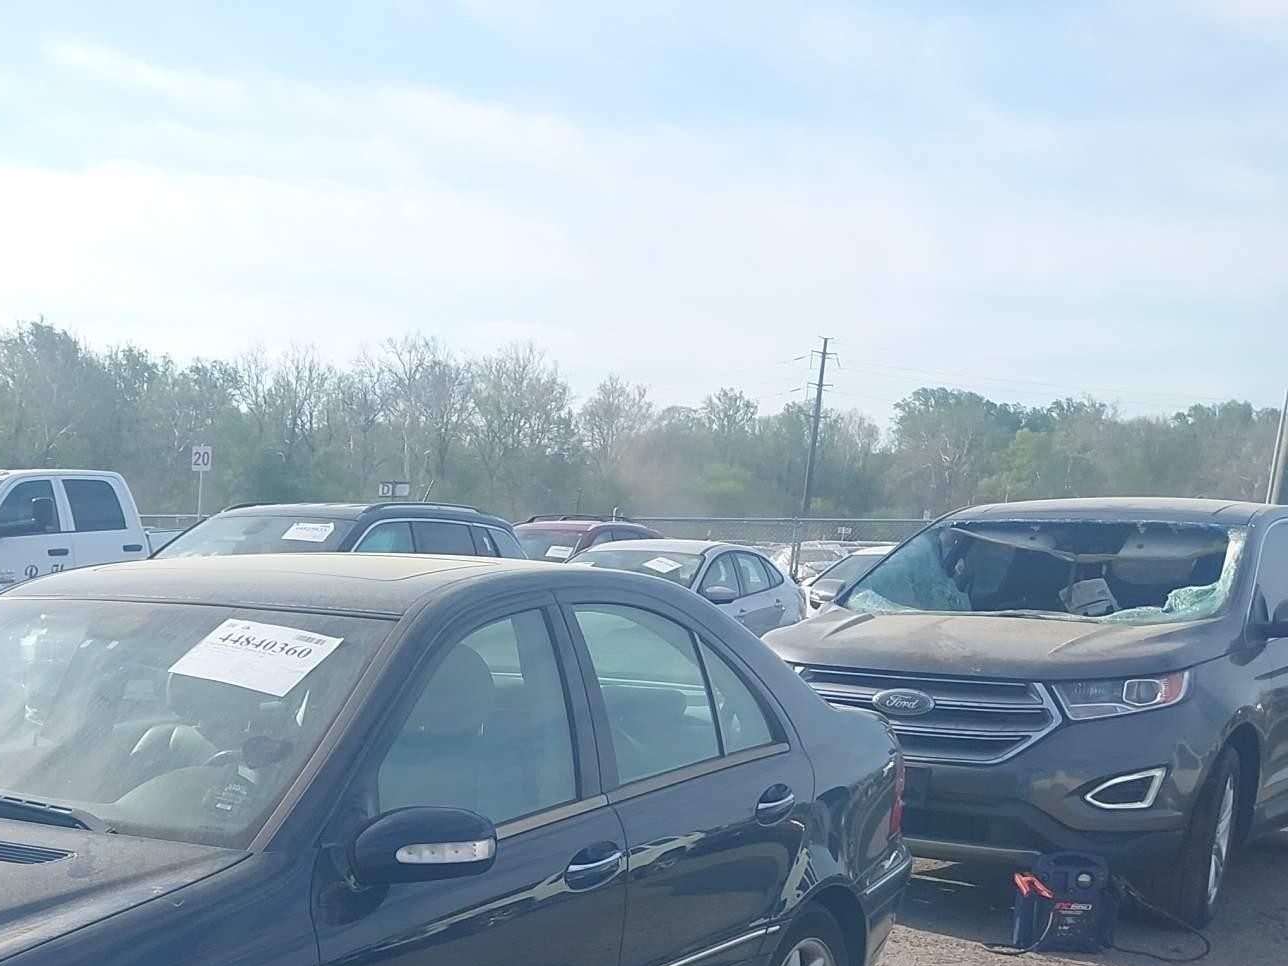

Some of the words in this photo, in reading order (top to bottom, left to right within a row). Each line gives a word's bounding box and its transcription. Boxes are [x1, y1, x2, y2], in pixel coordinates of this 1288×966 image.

[193, 451, 210, 466] 20
[382, 484, 390, 496] D
[218, 632, 313, 659] 44840360
[886, 695, 919, 709] Ford
